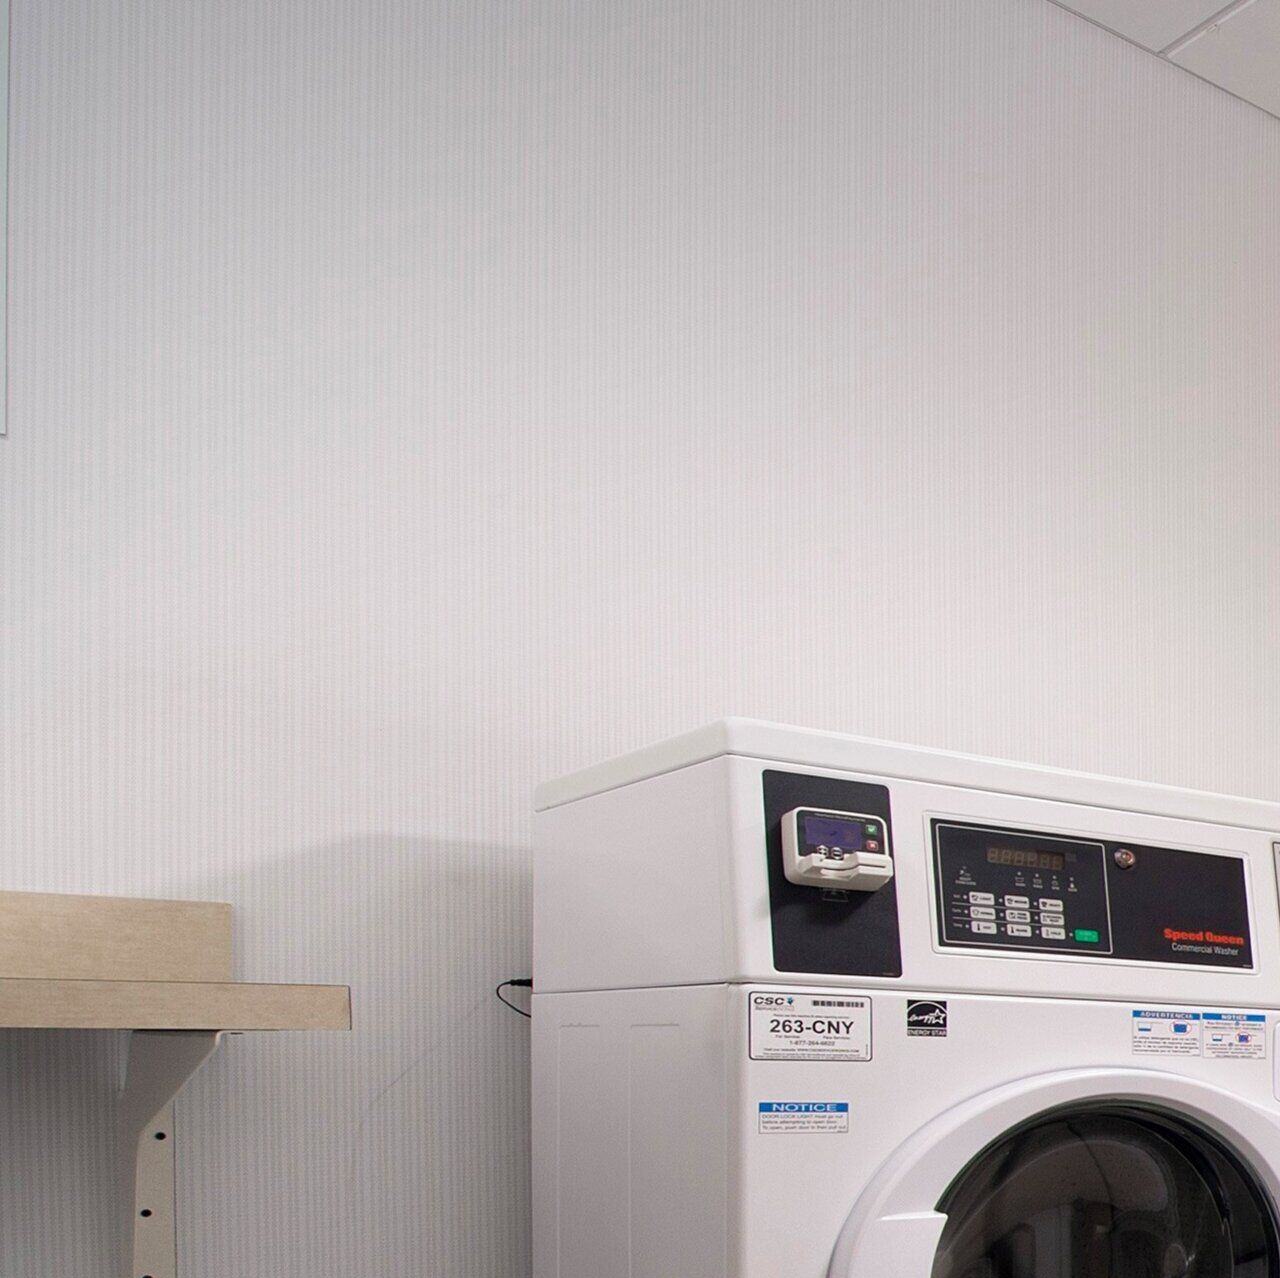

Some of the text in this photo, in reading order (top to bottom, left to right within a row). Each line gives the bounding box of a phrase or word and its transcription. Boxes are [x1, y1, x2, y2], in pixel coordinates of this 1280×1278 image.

[1163, 928, 1244, 945] Speed Queen
[1171, 942, 1239, 955] Commercial Washer
[754, 996, 785, 1005] CSC
[1140, 1011, 1193, 1020] ADVERTENCIA
[770, 1018, 854, 1034] 263-CNY
